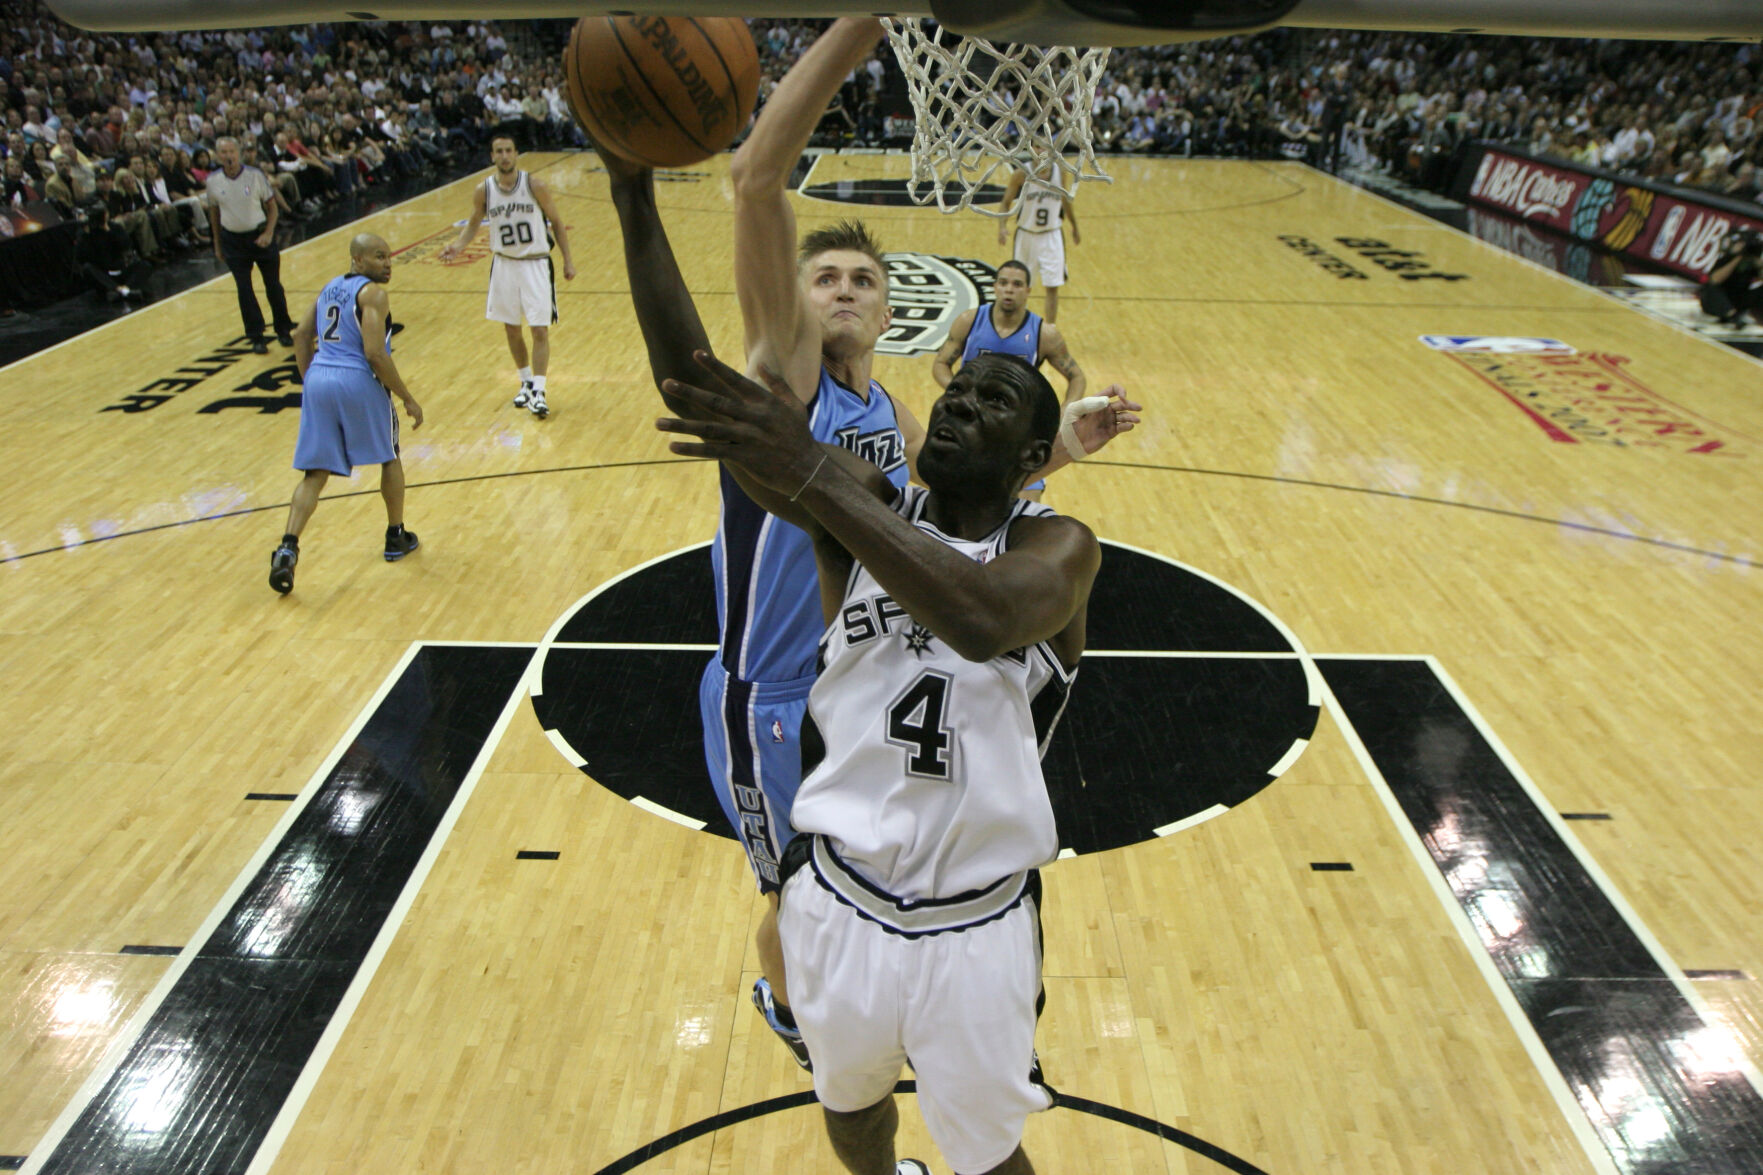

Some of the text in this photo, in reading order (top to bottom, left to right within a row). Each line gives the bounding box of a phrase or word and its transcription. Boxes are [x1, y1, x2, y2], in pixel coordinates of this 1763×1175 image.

[489, 203, 534, 218] SPURS
[1035, 208, 1048, 227] 9
[500, 221, 532, 247] 20
[323, 304, 341, 342] 2
[98, 322, 299, 413] ENTER
[884, 667, 954, 783] 4
[735, 783, 780, 885] UTAH
